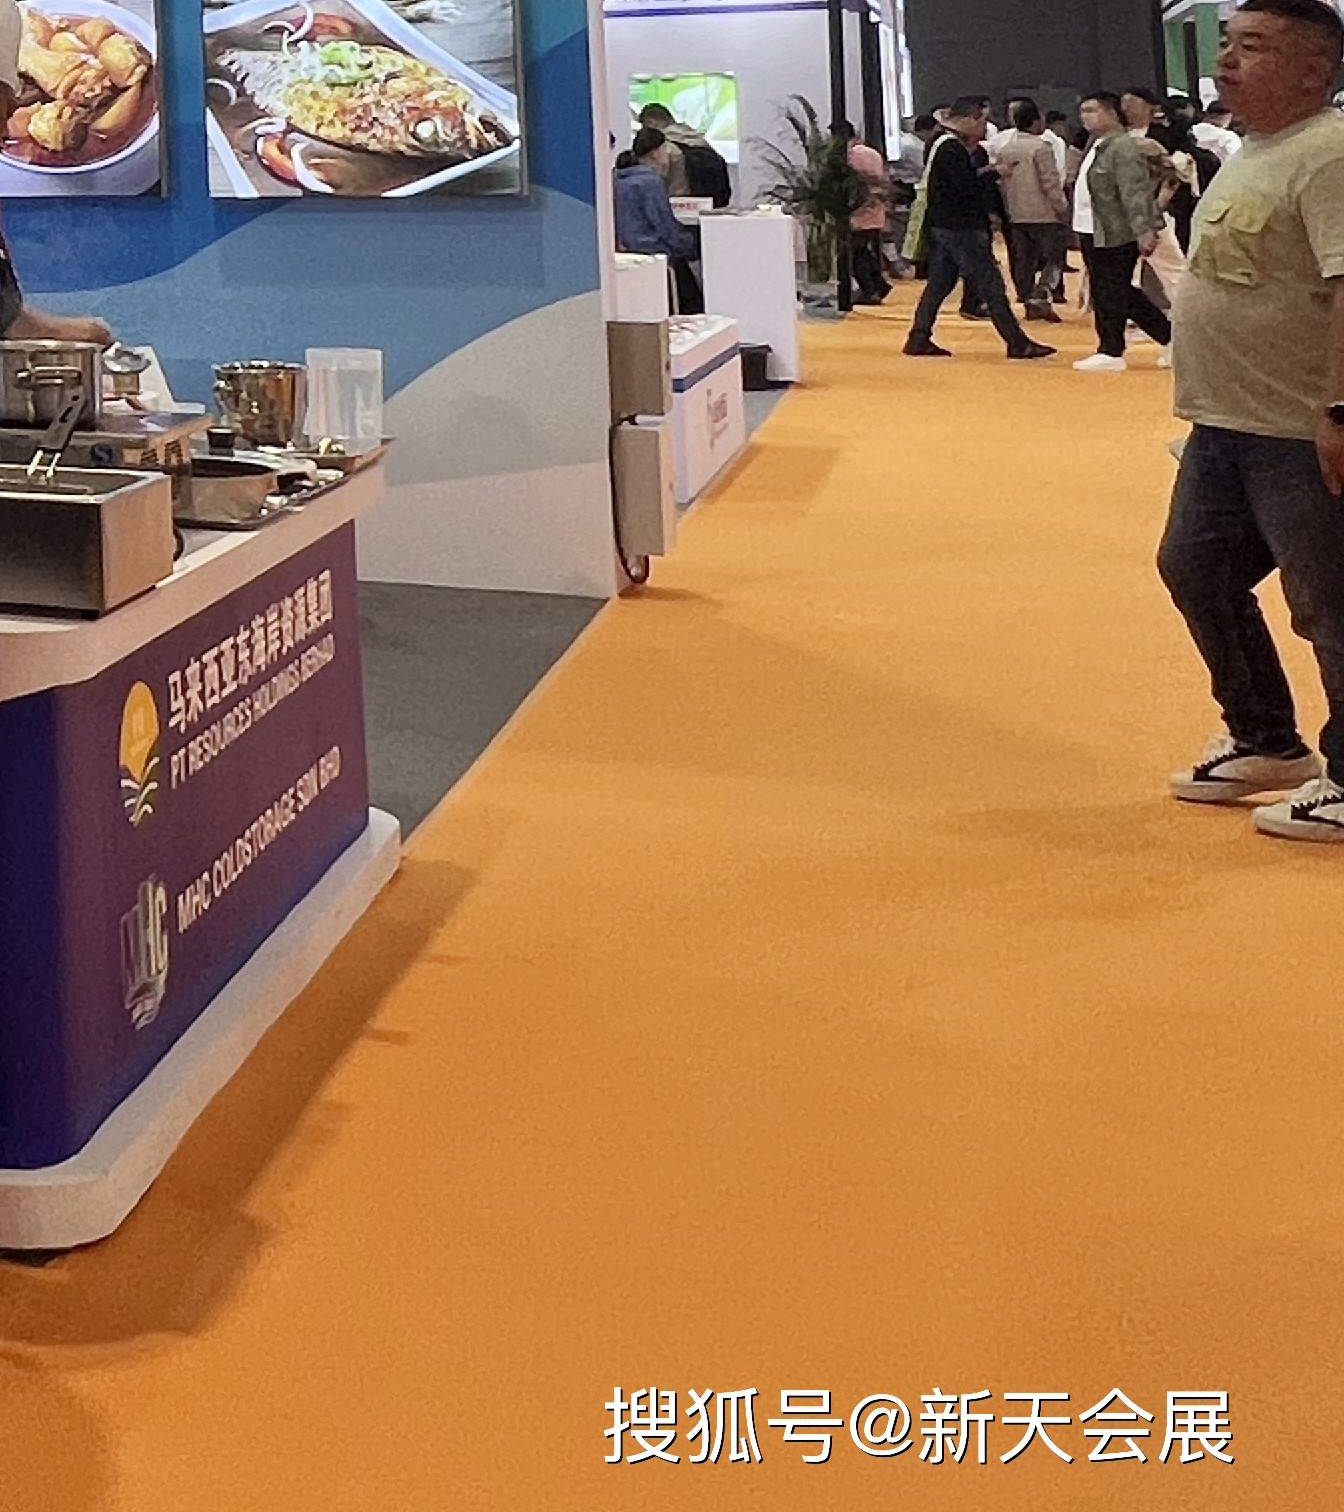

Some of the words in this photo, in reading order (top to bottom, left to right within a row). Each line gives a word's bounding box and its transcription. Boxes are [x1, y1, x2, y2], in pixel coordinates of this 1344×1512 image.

[168, 568, 334, 734] 马来西亚东海岸资源集团
[170, 746, 186, 789] PT
[188, 696, 253, 776] RESOURCES
[176, 871, 212, 934] MHC
[213, 787, 296, 898] COLDSTORAGE
[296, 763, 319, 812] SDN
[319, 744, 342, 790] BHD
